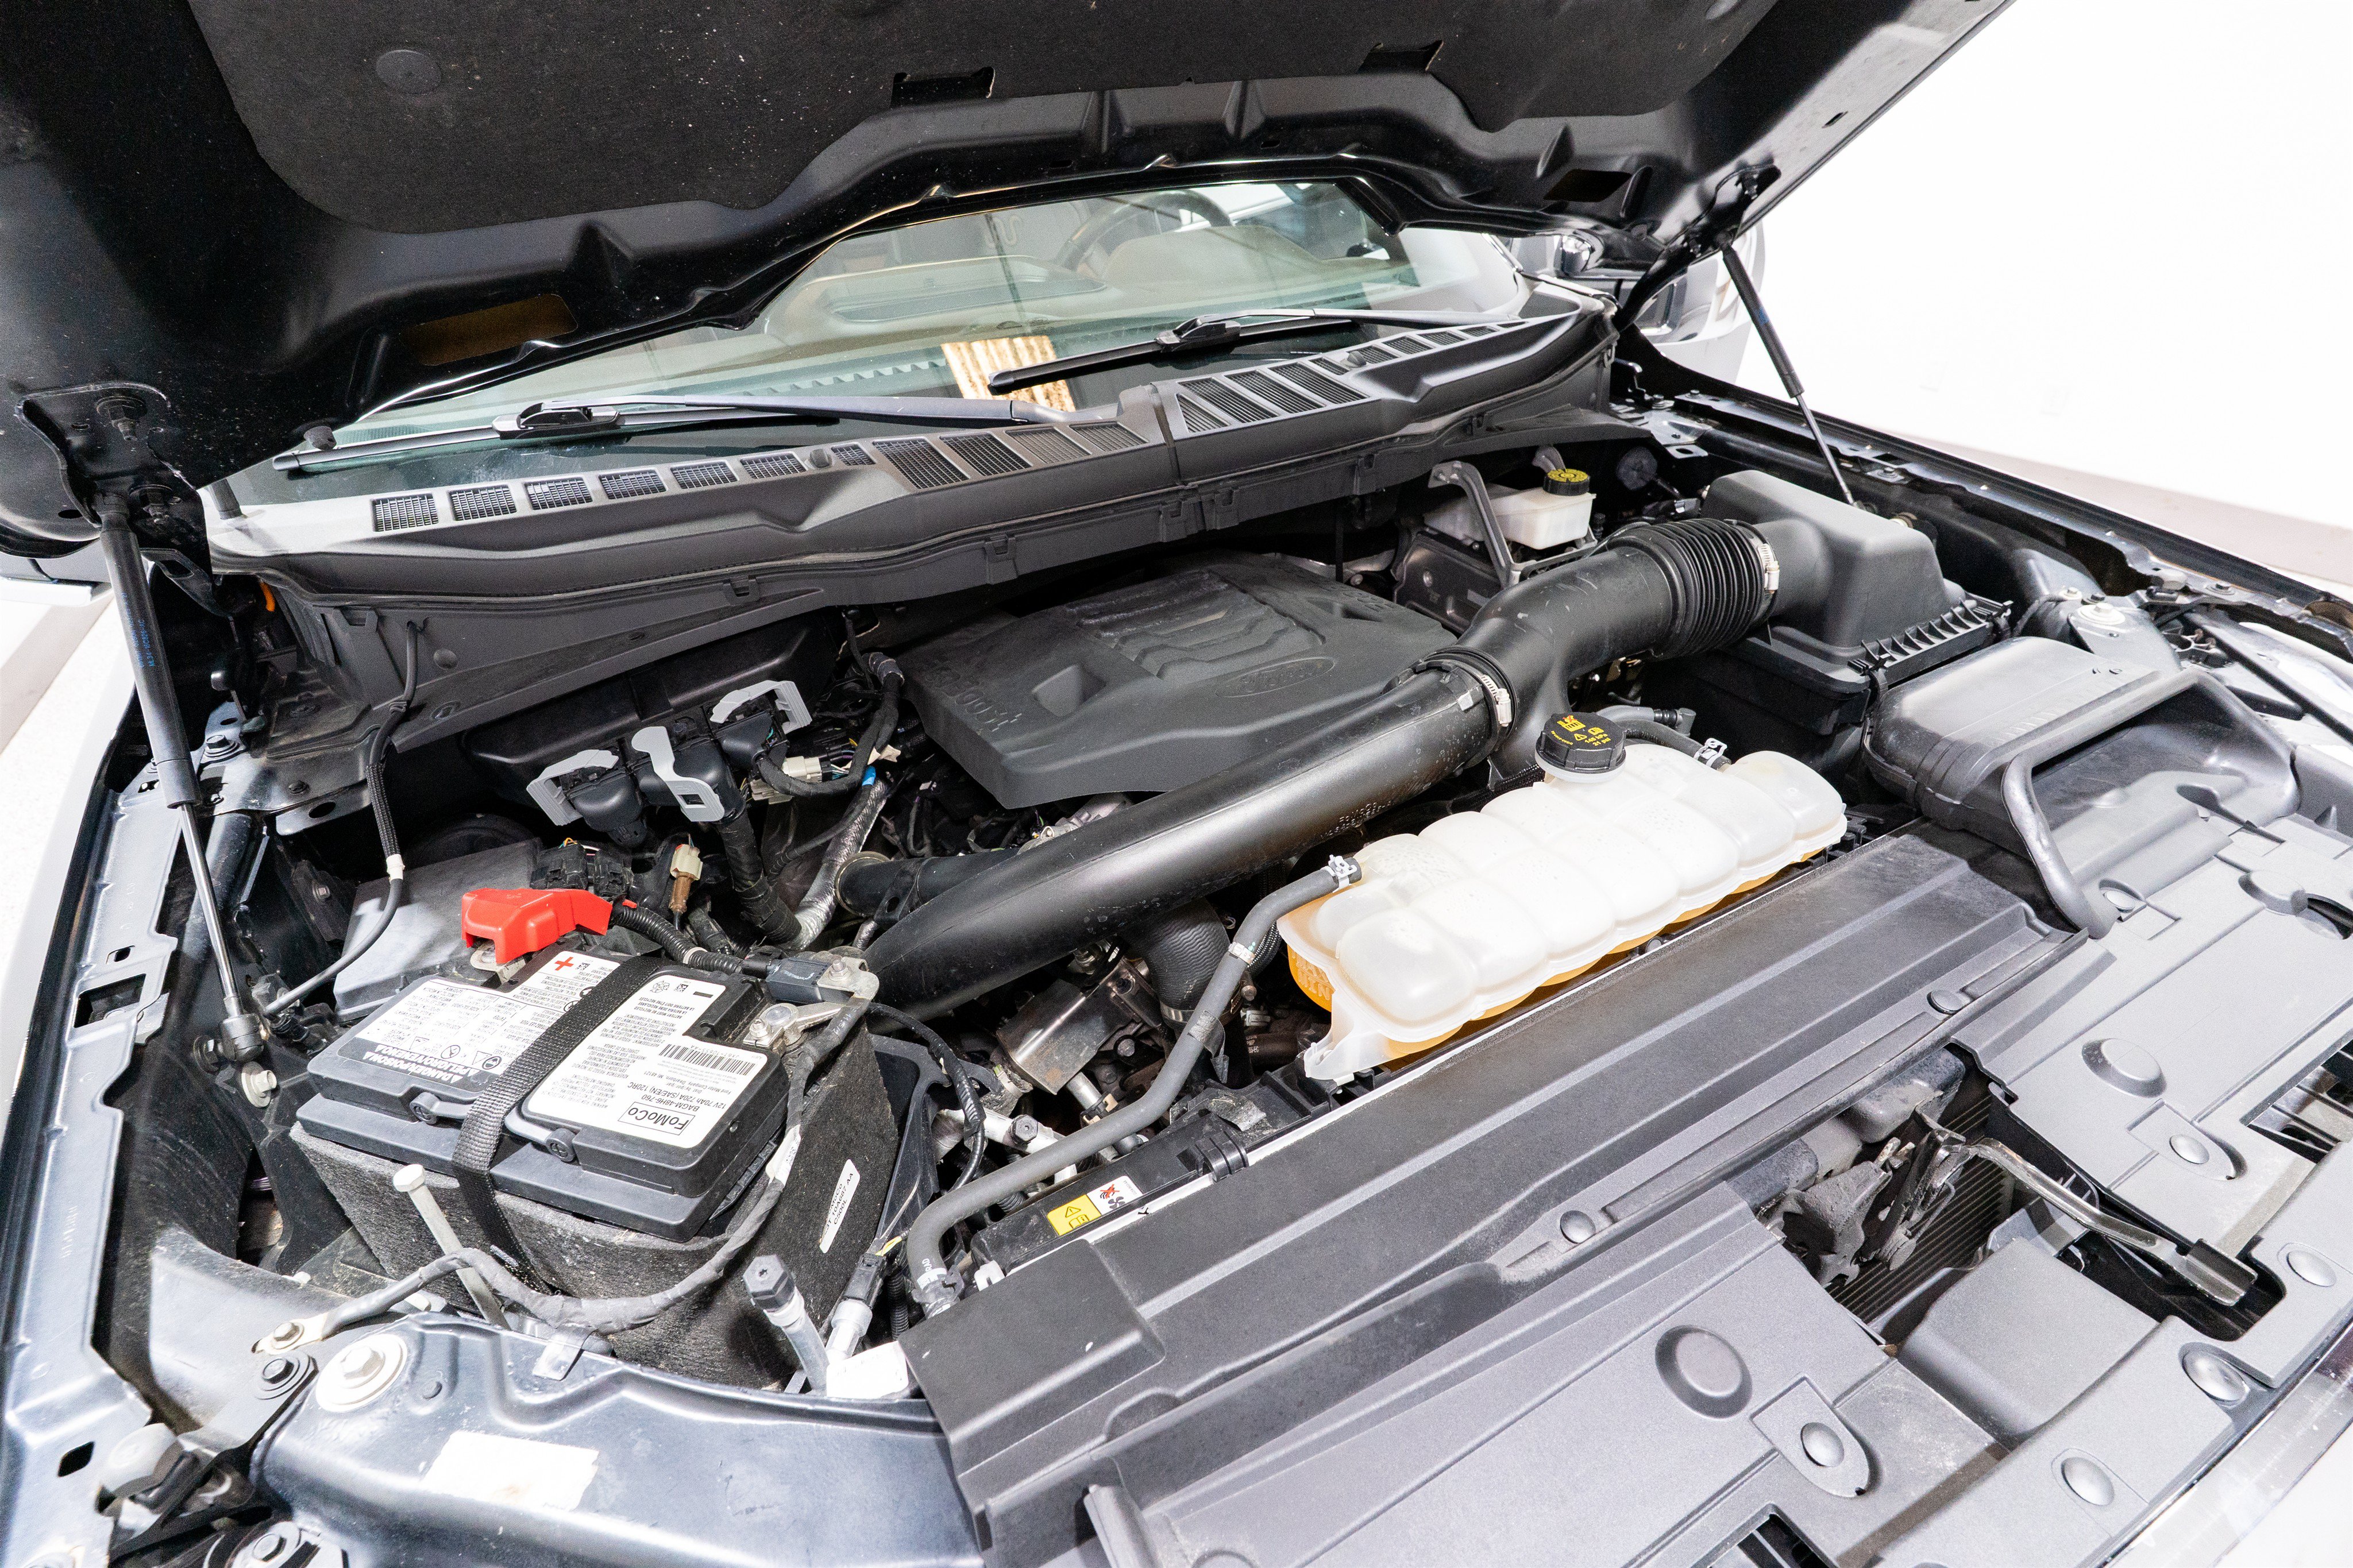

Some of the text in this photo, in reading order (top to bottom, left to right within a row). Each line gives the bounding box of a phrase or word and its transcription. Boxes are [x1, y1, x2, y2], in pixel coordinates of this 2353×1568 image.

[1298, 968, 1330, 1001] MIN
[365, 1052, 455, 1081] DANGER/POISON
[377, 1045, 472, 1075] PELIGRO/VENENO
[626, 1082, 649, 1091] 120RC
[648, 1087, 680, 1098] (SAE/EN)
[640, 1094, 700, 1111] BAGM-48H6-760
[678, 1094, 696, 1102] 720A
[695, 1098, 713, 1106] 70Ah
[624, 1107, 689, 1130] FoMoCo
[845, 1172, 854, 1185] AA
[833, 1198, 847, 1225] C500L
[922, 1258, 932, 1272] RAD
